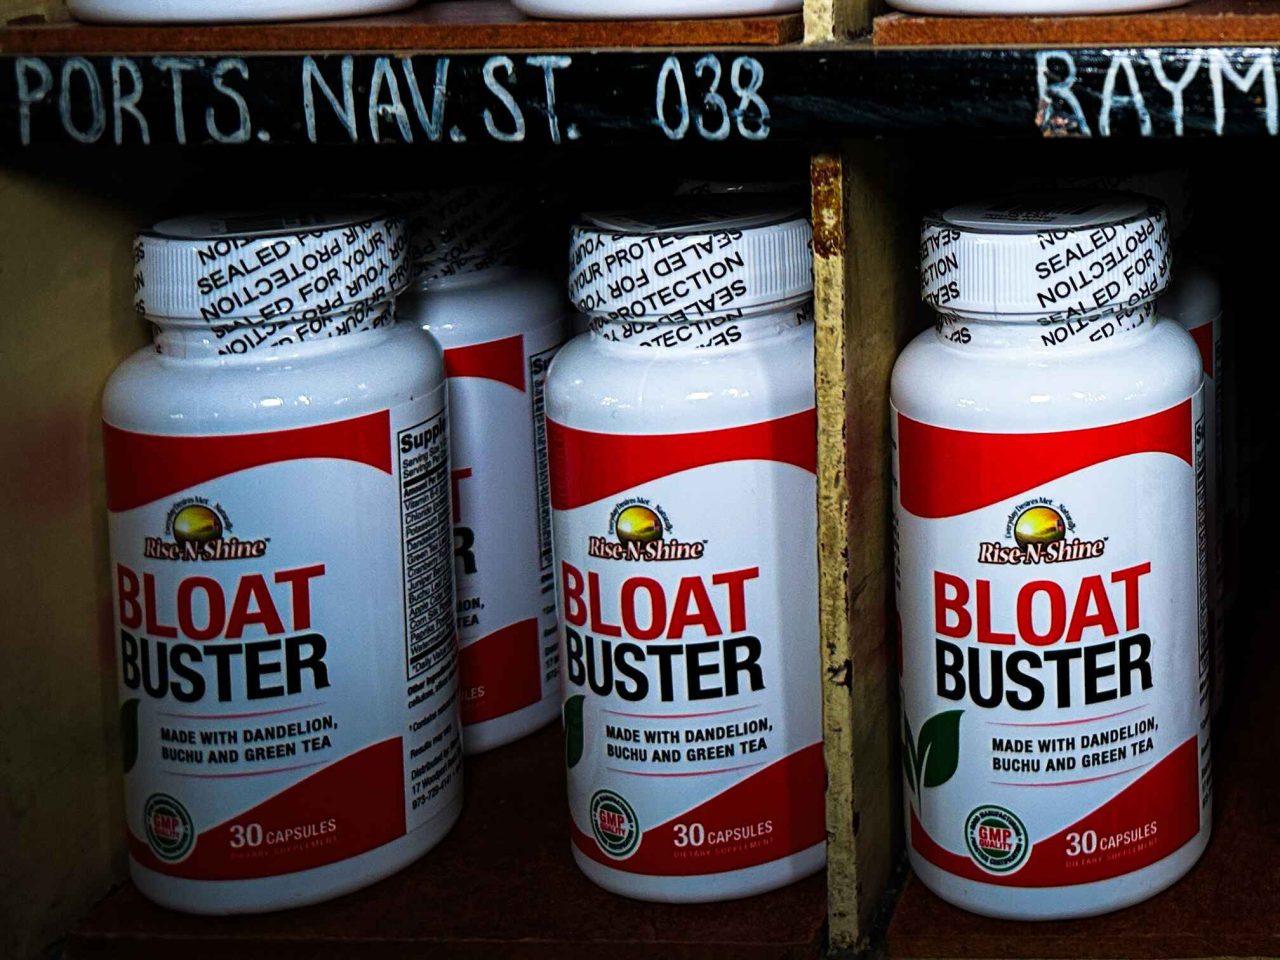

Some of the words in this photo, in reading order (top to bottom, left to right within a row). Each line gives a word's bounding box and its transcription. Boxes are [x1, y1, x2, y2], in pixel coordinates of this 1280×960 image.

[15, 56, 271, 145] PORTS.
[654, 55, 771, 141] 038
[197, 241, 290, 295] SEALED
[654, 229, 744, 277] SEALED
[1035, 226, 1117, 280] SEALED
[1123, 248, 1155, 286] FOR
[200, 236, 341, 322] PROTECTION
[607, 268, 650, 299] FOR
[144, 537, 266, 561] Rise-N-Shine
[589, 537, 704, 561] Rise-N-Shine
[978, 538, 1105, 565] Rise-N-Shine
[117, 563, 325, 641] BLOAT
[562, 561, 759, 641] BLOAT
[934, 562, 1151, 646] BLOAT
[120, 629, 331, 703] BUSTER
[565, 625, 766, 702] BUSTER
[936, 633, 1153, 711] BUSTER
[606, 725, 640, 743] MADE
[643, 730, 680, 744] WITH
[685, 717, 773, 743] DANDELION,
[992, 738, 1033, 753] MADE
[1038, 738, 1075, 753] WITH
[1081, 717, 1158, 749] DANDELION,
[607, 743, 647, 762] BUCHU
[652, 748, 681, 762] AND
[687, 744, 735, 761] GREEN
[740, 738, 767, 755] TEA
[992, 757, 1040, 772] BUCHU
[1045, 757, 1076, 772] AND
[1082, 748, 1126, 768] GREEN
[1130, 737, 1154, 757] TEA
[230, 823, 263, 848] 30
[265, 818, 336, 846] CAPSULES
[673, 823, 704, 847] 30
[708, 820, 773, 844] CAPSULES
[979, 825, 1012, 841] GMP
[1066, 830, 1097, 857] 30
[1099, 821, 1157, 851] CAPSULES
